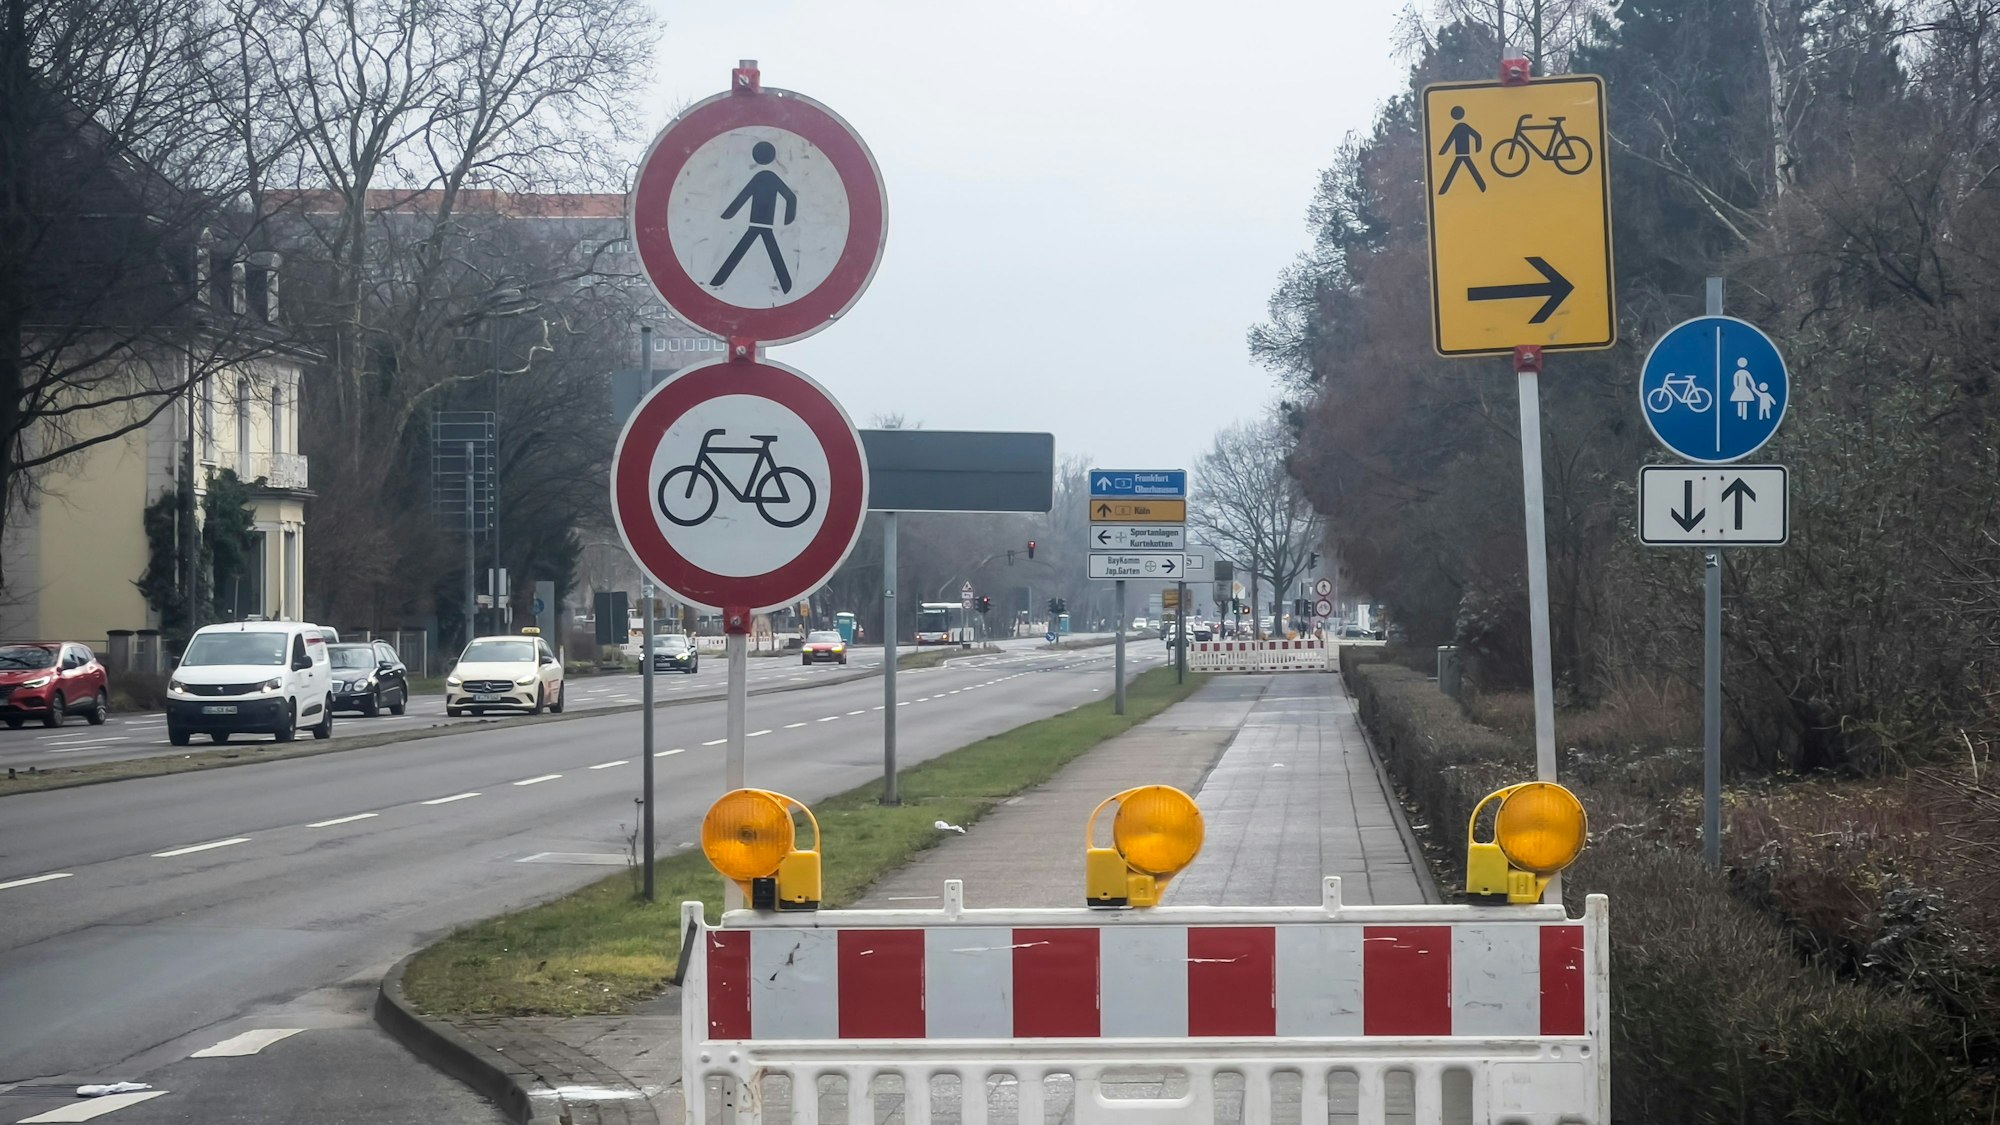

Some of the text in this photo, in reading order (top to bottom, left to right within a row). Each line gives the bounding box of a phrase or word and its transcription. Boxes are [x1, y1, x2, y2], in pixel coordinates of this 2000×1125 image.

[1135, 474, 1168, 482] Frankfurt
[1135, 485, 1179, 493] Oberhausen
[1134, 506, 1151, 514] Köln
[1130, 528, 1179, 537] Sportanlagen
[1130, 539, 1173, 547] Kurtekotten
[1107, 557, 1140, 566] BayKomm
